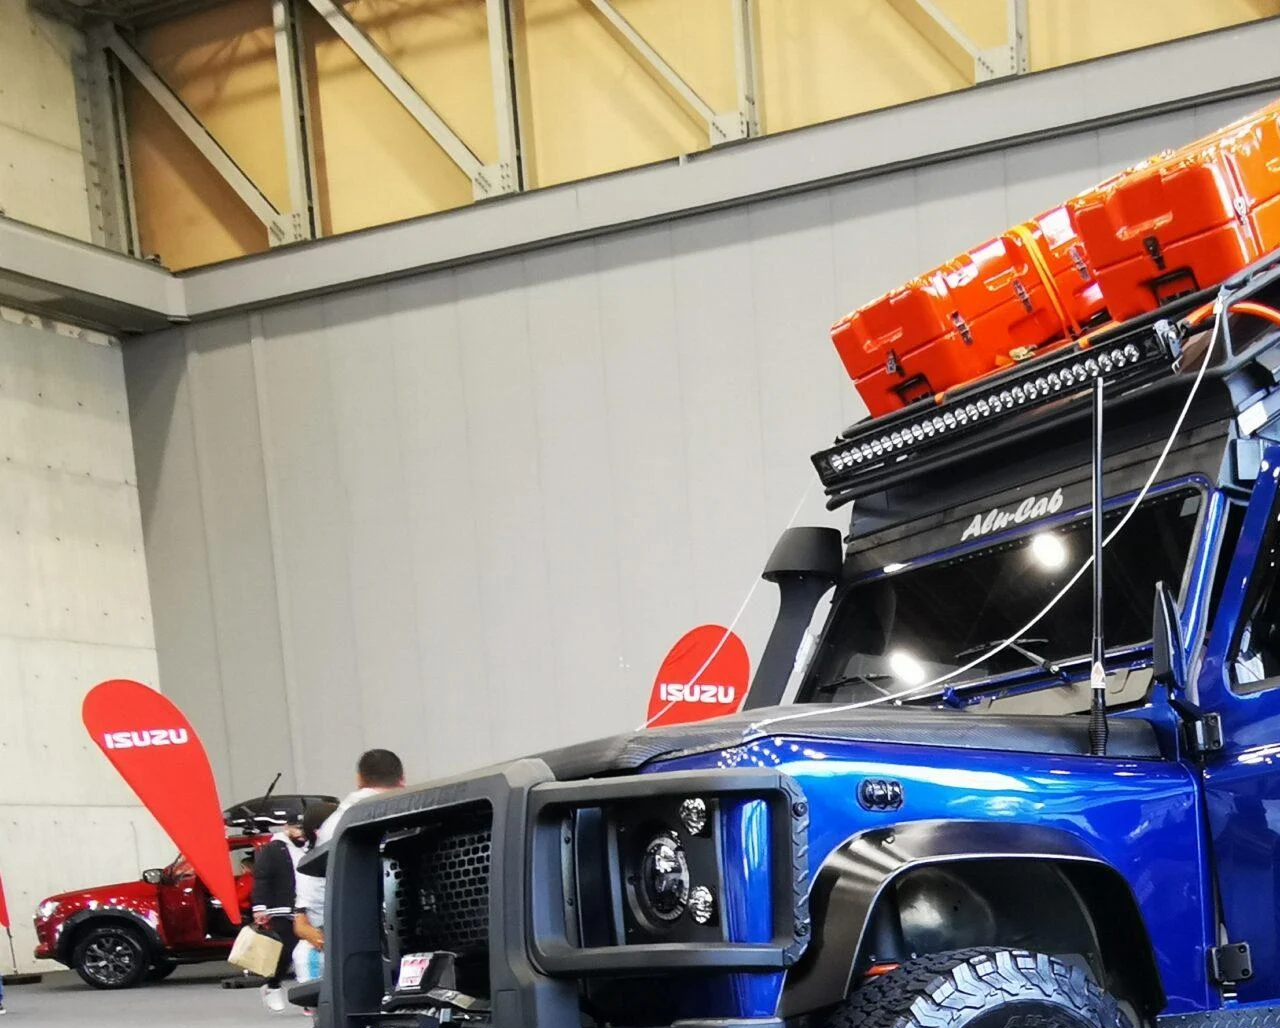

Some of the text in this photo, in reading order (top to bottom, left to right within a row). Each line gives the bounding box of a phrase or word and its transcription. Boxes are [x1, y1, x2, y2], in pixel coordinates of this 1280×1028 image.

[960, 487, 1064, 542] Alu-Cab
[660, 683, 736, 704] ISUZU
[104, 728, 189, 750] ISUZU
